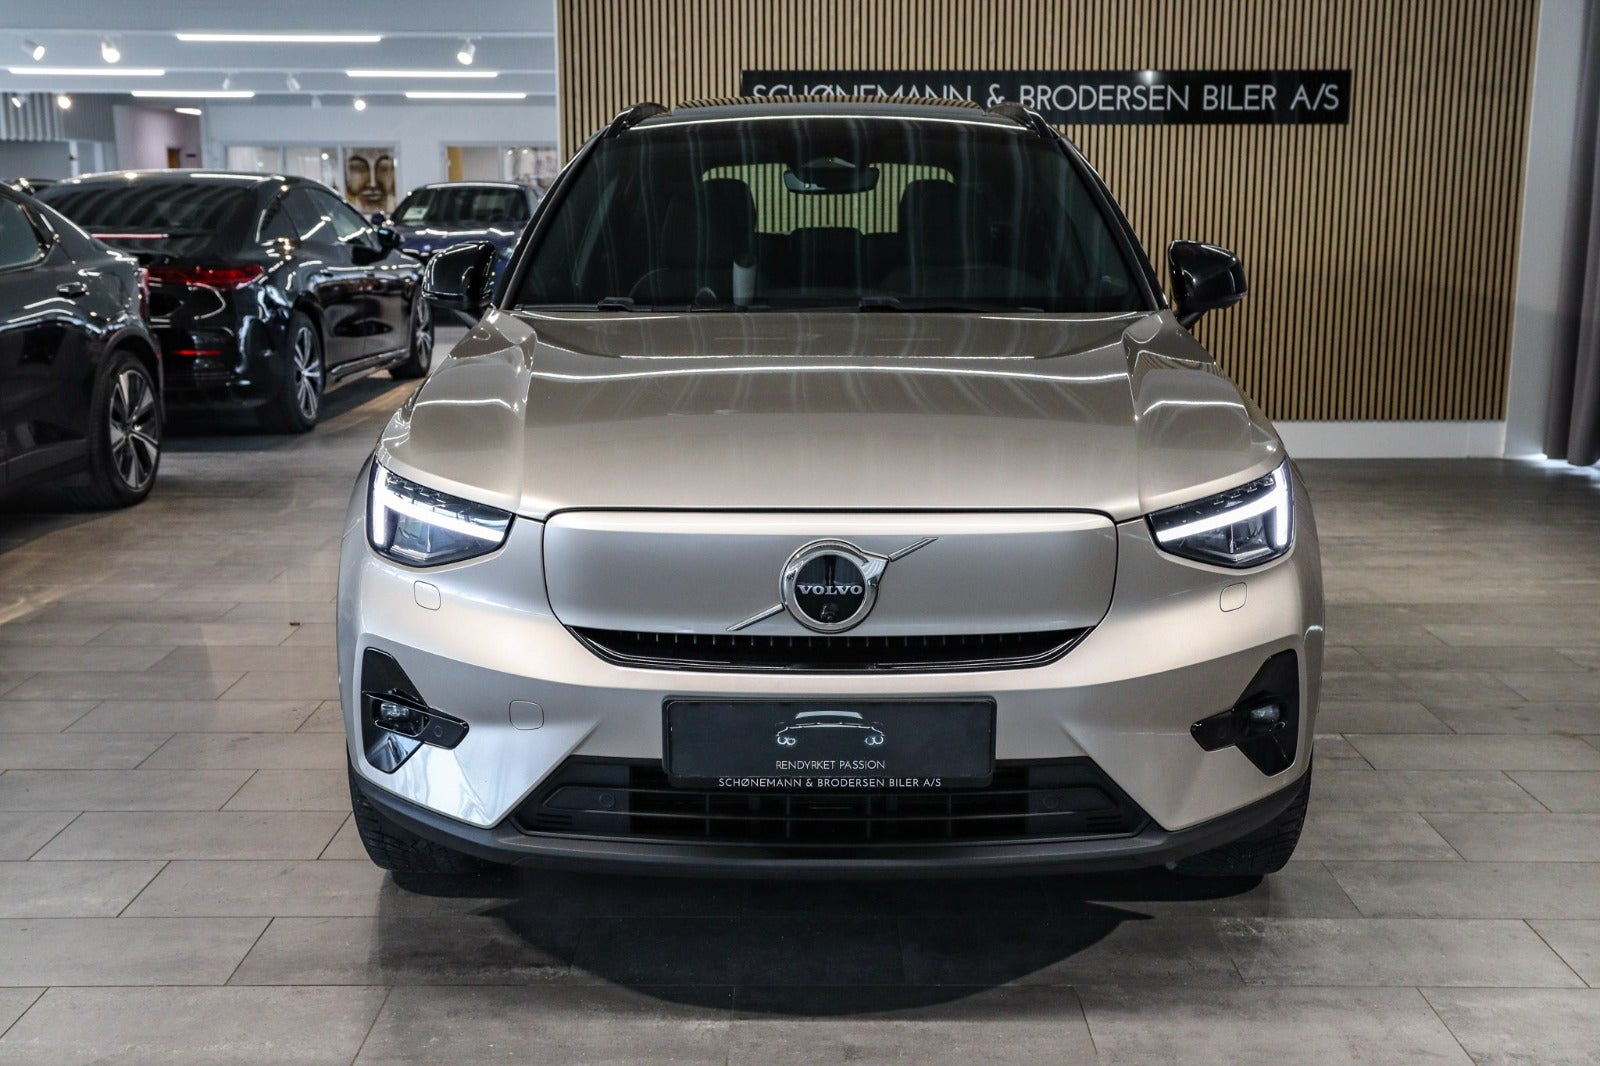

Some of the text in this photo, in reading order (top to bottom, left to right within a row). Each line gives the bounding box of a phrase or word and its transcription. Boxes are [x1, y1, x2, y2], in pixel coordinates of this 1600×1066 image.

[987, 84, 1005, 108] &
[1020, 84, 1189, 111] BRODERSEN
[1203, 84, 1277, 111] BILER
[1290, 83, 1339, 112] A/S
[797, 584, 863, 595] VOLVO
[775, 760, 886, 770] RENDYRKET PASSION
[718, 778, 942, 788] SCHØNEMANN & BRODERSEN BILER A/S
